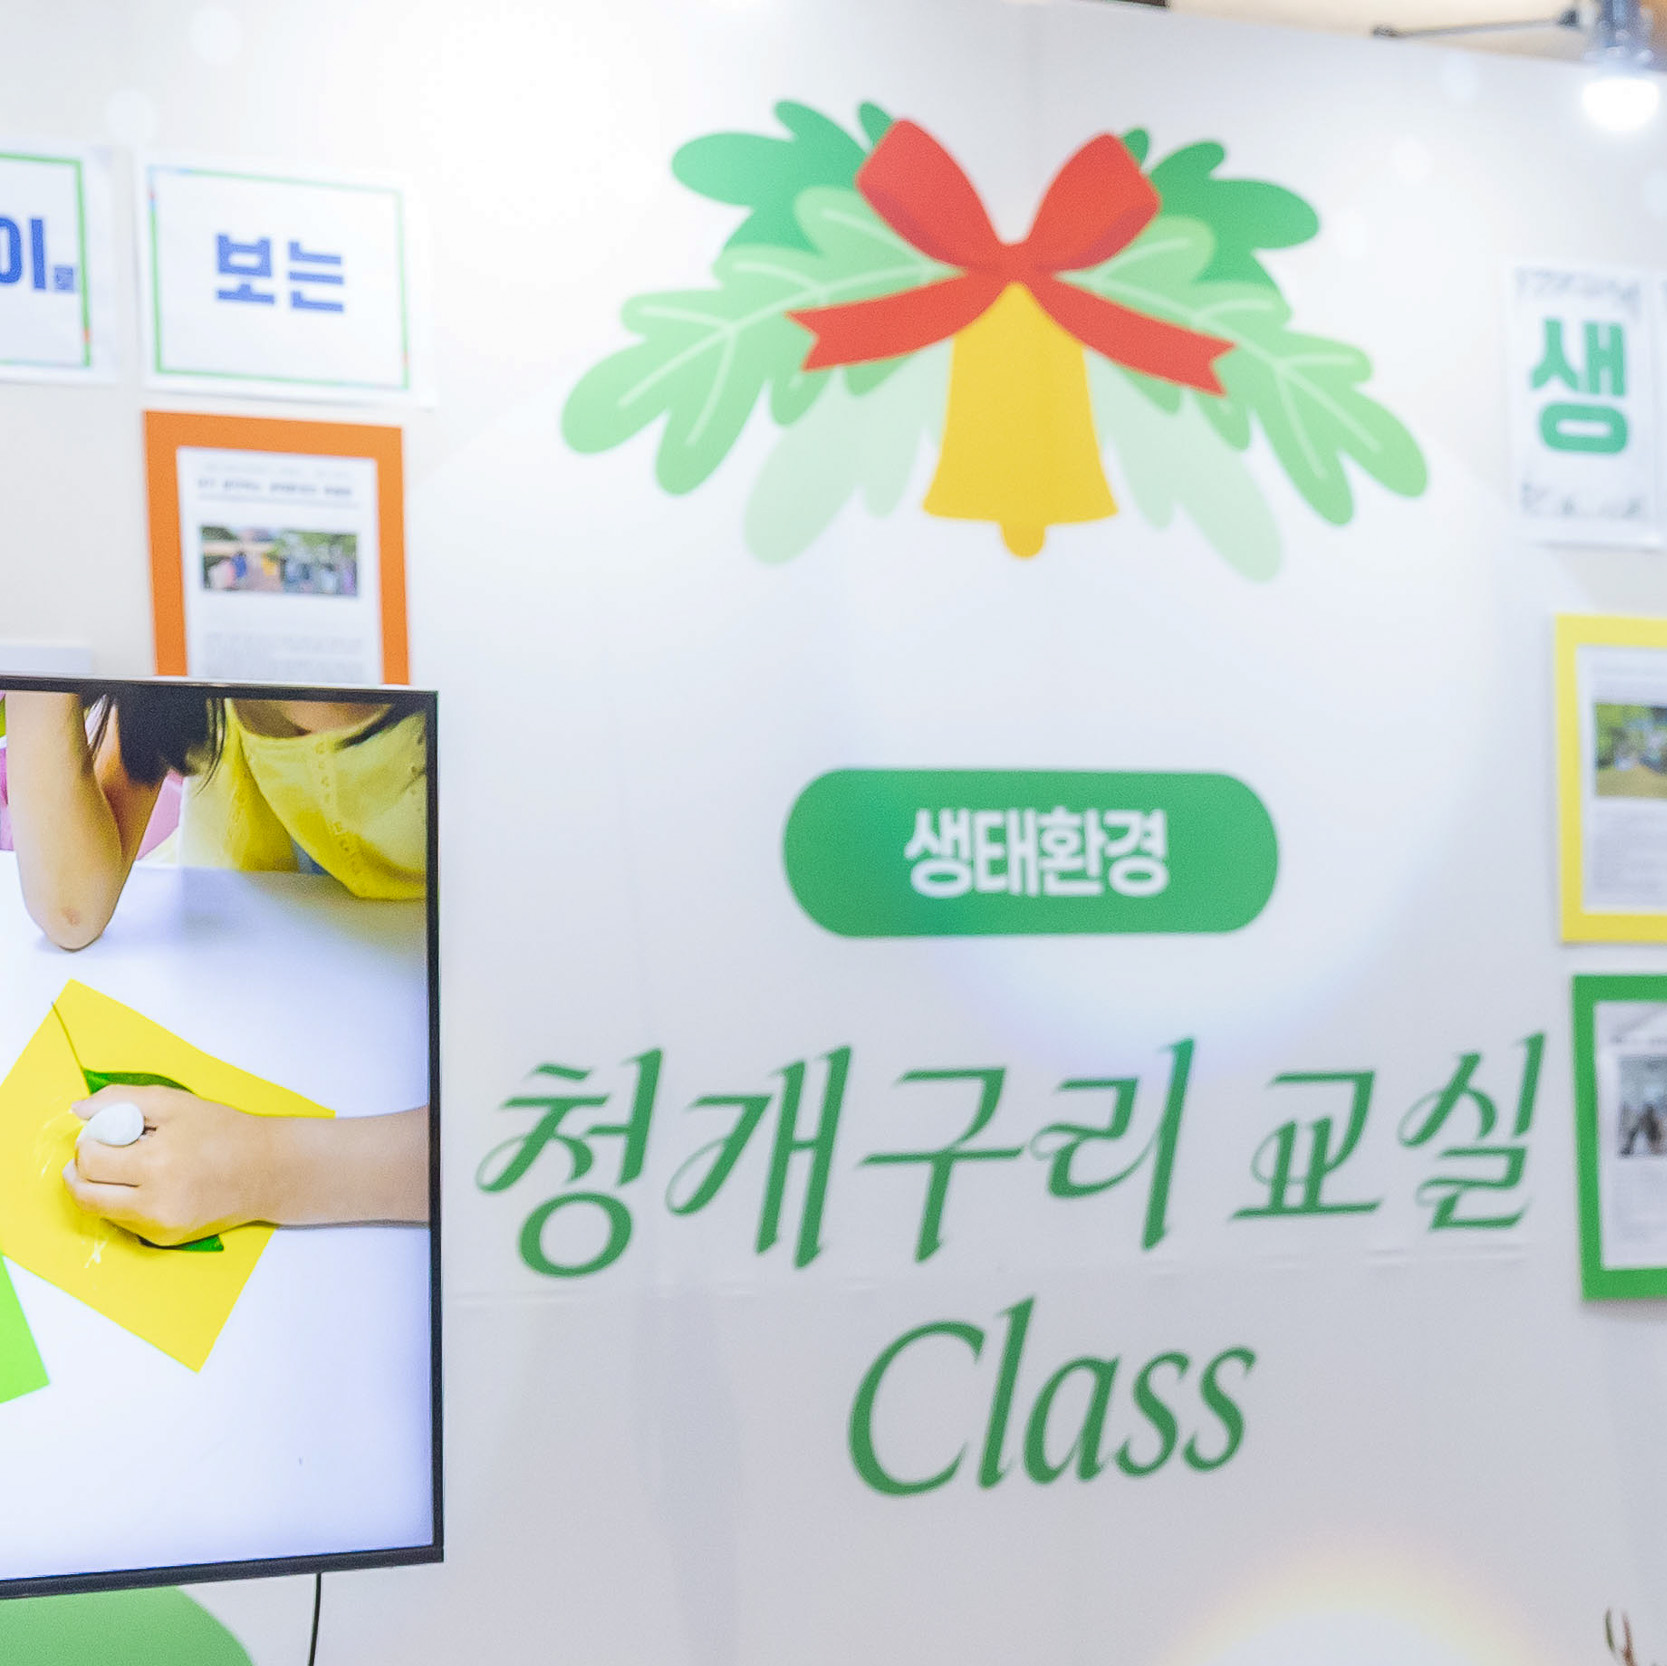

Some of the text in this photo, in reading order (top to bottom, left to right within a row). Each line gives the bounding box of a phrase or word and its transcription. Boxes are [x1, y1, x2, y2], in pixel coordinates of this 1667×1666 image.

[214, 232, 345, 313] 보는
[904, 806, 1170, 898] 생태환경
[476, 1031, 1546, 1279] 청개구리 교실
[848, 1297, 1257, 1497] Class
